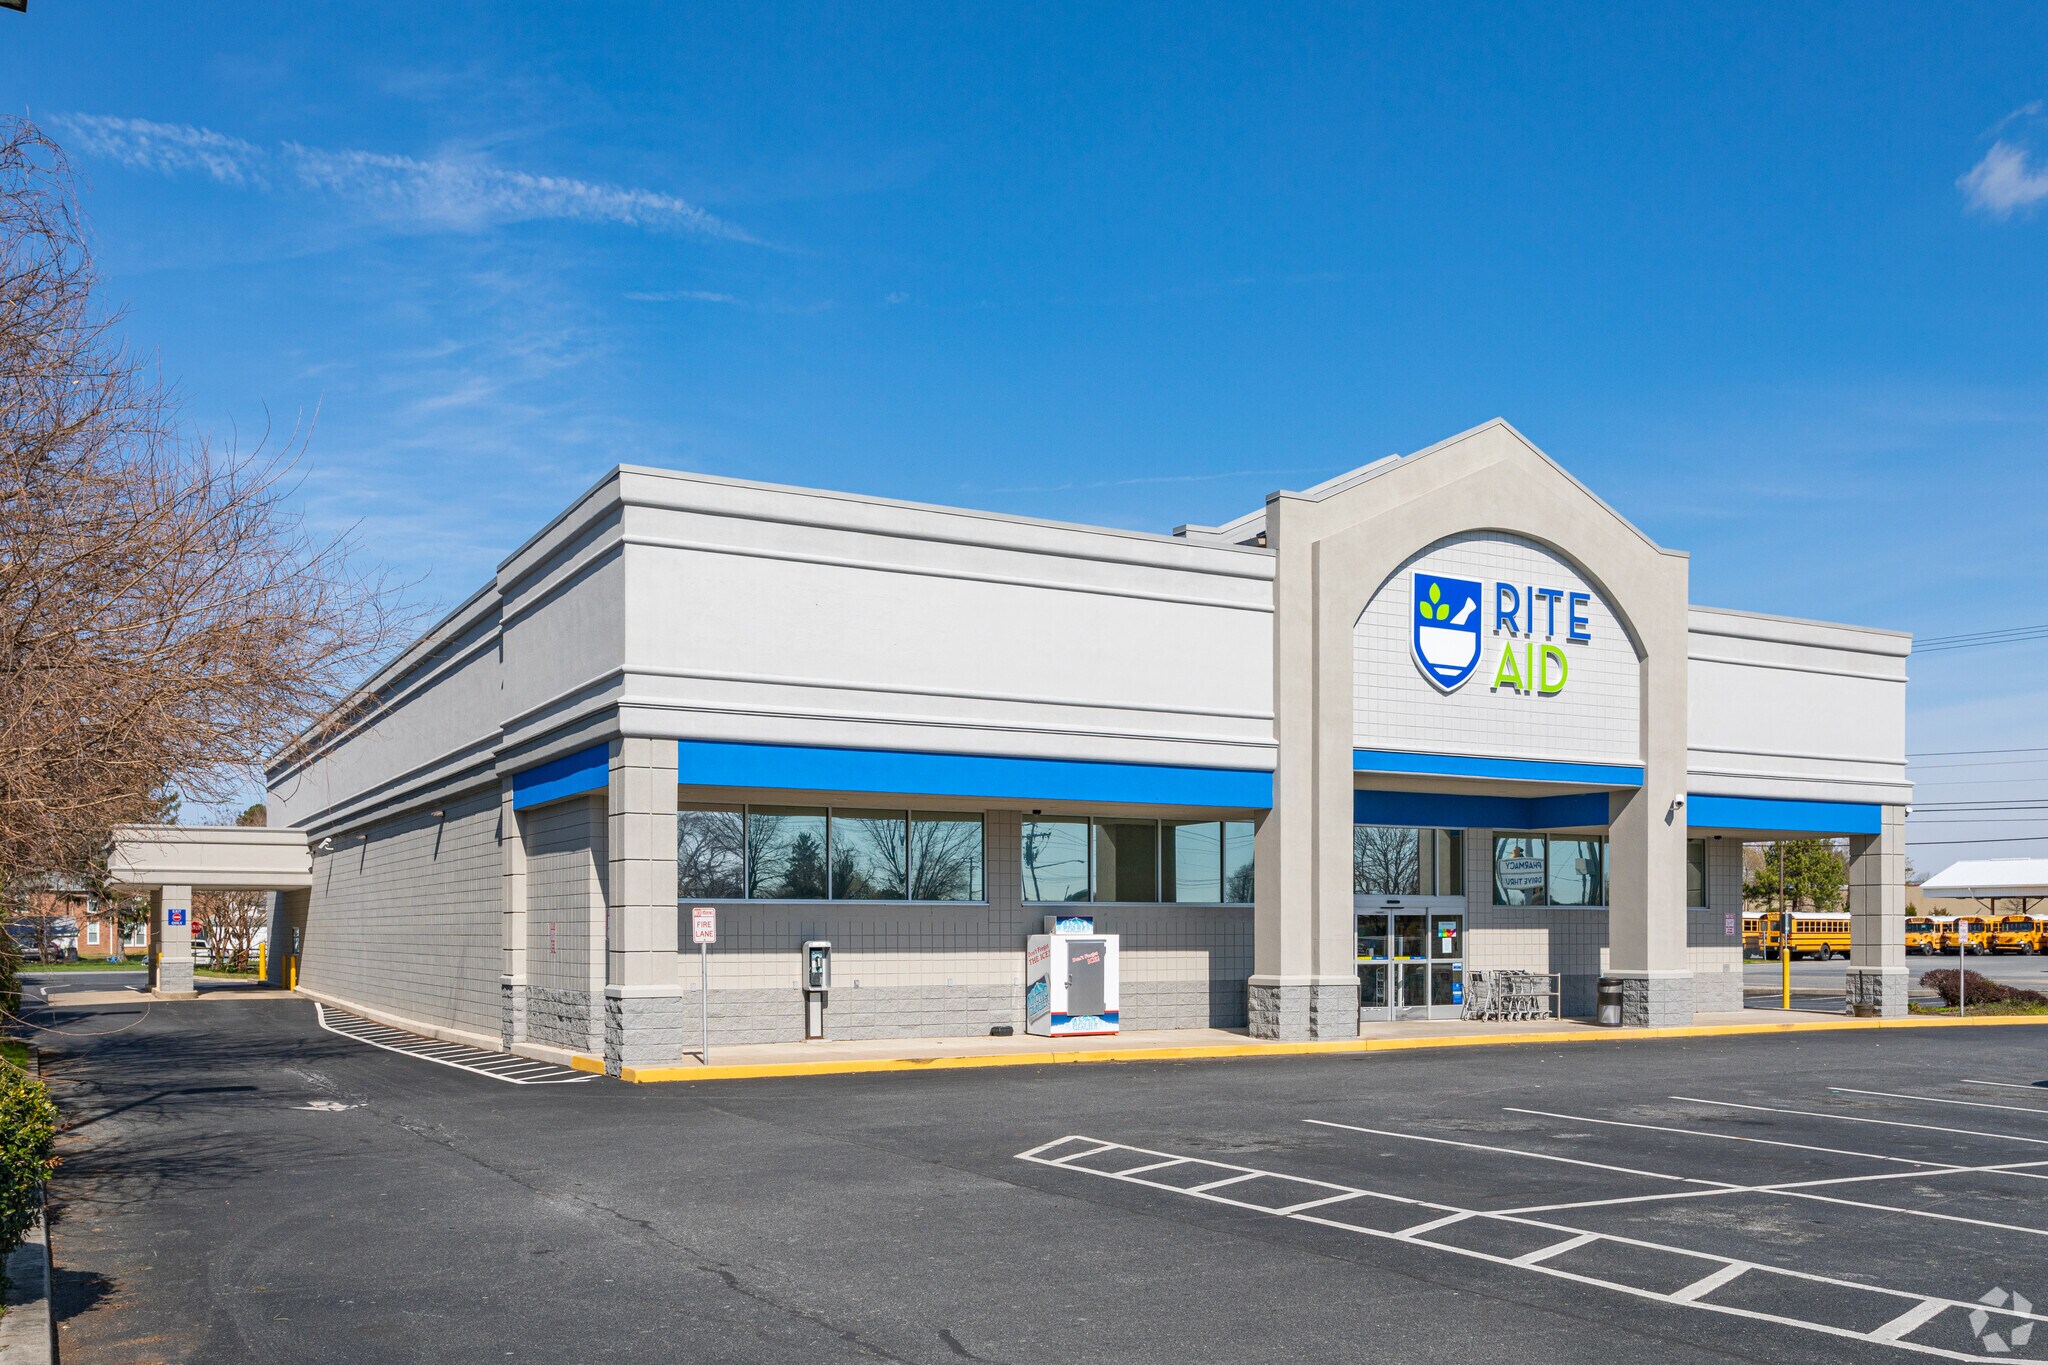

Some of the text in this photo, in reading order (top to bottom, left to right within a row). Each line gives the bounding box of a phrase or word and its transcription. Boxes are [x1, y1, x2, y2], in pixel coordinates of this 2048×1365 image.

[1496, 582, 1592, 641] RITE
[1494, 640, 1569, 693] AID
[1029, 955, 1040, 966] THE
